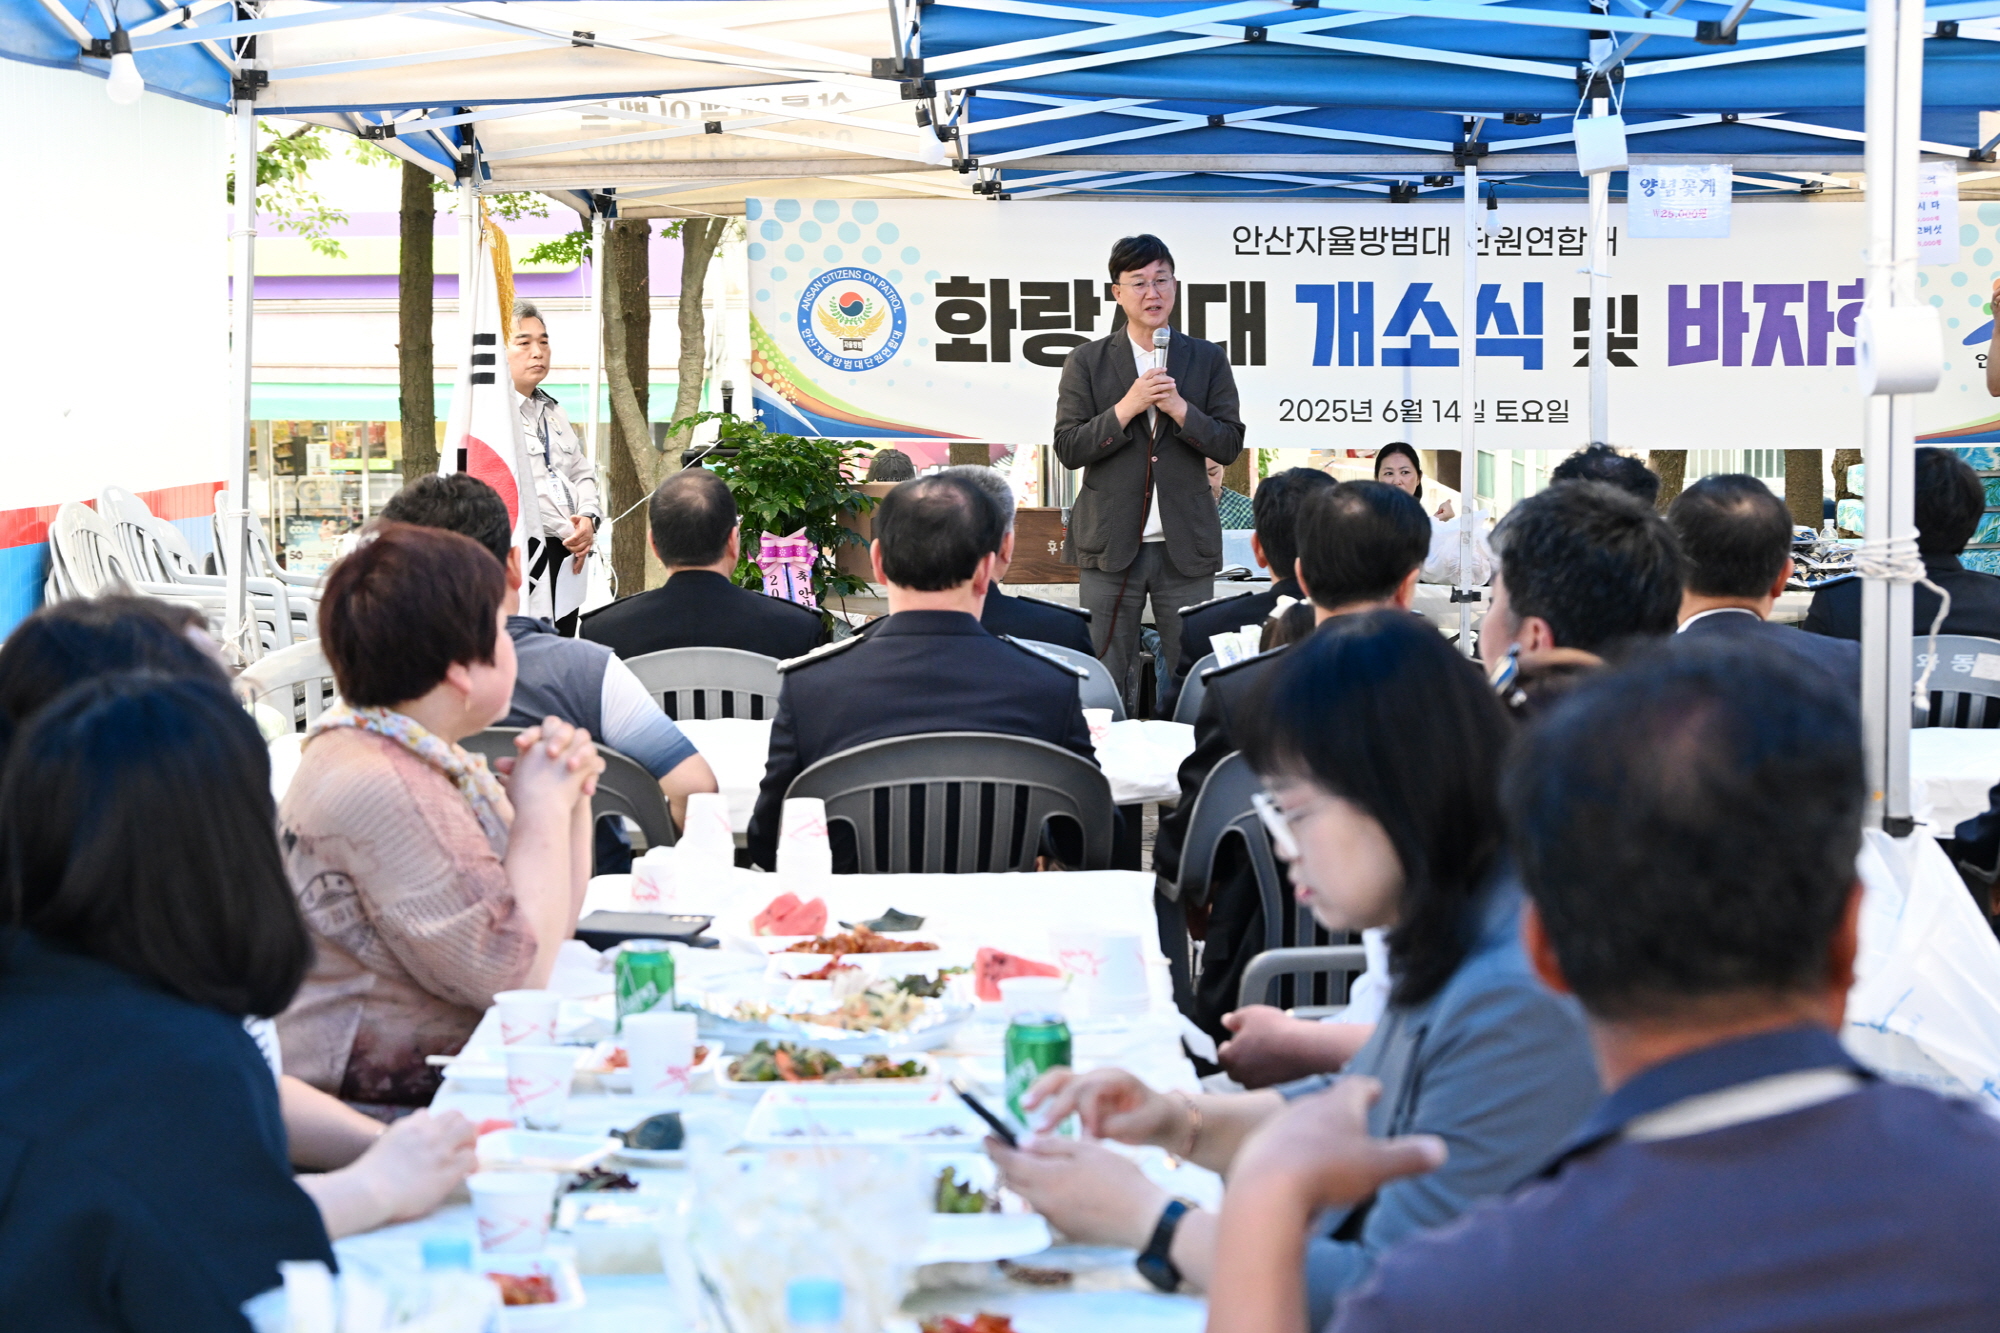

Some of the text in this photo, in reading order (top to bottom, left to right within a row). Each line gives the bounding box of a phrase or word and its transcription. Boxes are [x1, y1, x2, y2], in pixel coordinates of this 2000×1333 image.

[1640, 178, 1716, 197] 양념꽃게
[1233, 226, 1450, 256] 안산자율방범대
[801, 269, 903, 313] ANSAN CITIZENS ON PATROL
[1295, 281, 1544, 371] 개소식
[1572, 294, 1639, 367] 및
[1279, 398, 1373, 423] 2025년
[1382, 398, 1423, 423] 6월
[1495, 398, 1569, 423] 토요일
